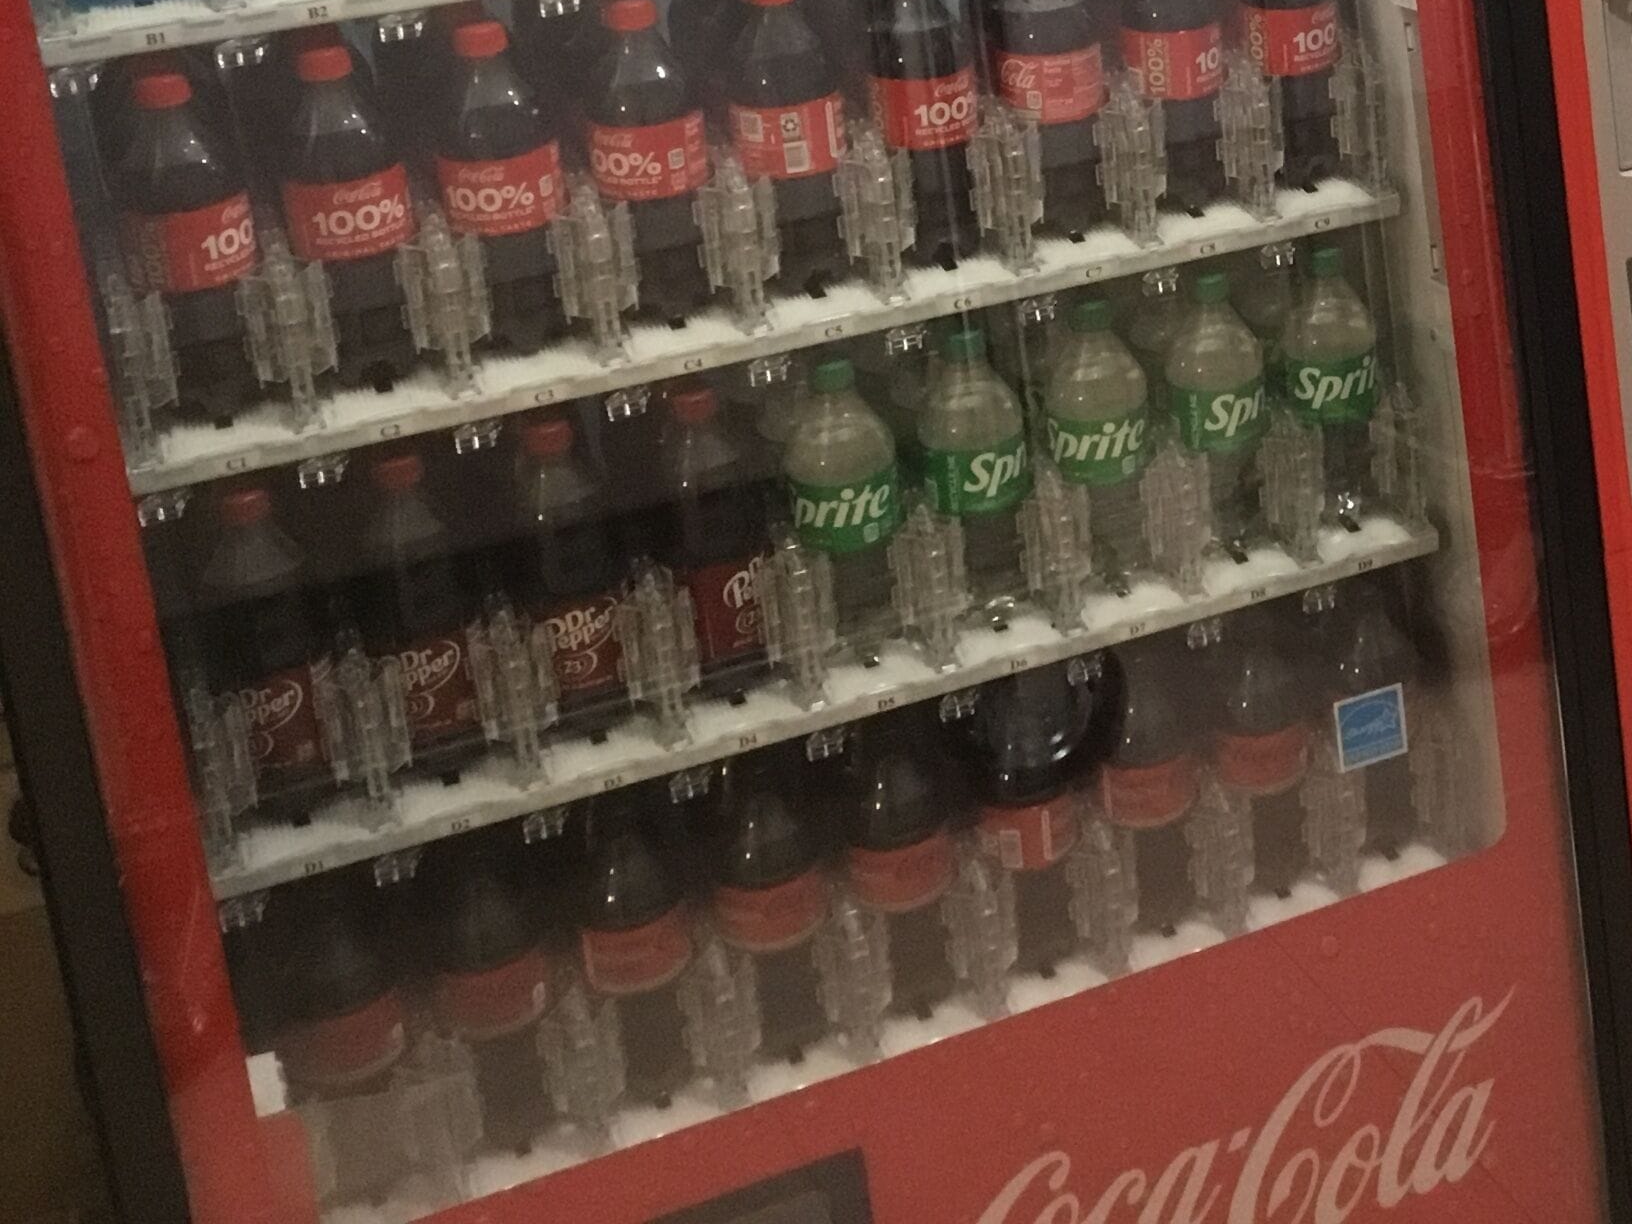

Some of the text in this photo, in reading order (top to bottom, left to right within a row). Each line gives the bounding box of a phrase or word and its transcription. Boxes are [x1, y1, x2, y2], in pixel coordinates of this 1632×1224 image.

[307, 6, 329, 20] B2
[146, 33, 167, 47] B1
[1148, 38, 1165, 95] 100%
[446, 181, 535, 212] 100%
[312, 194, 405, 237] 100%
